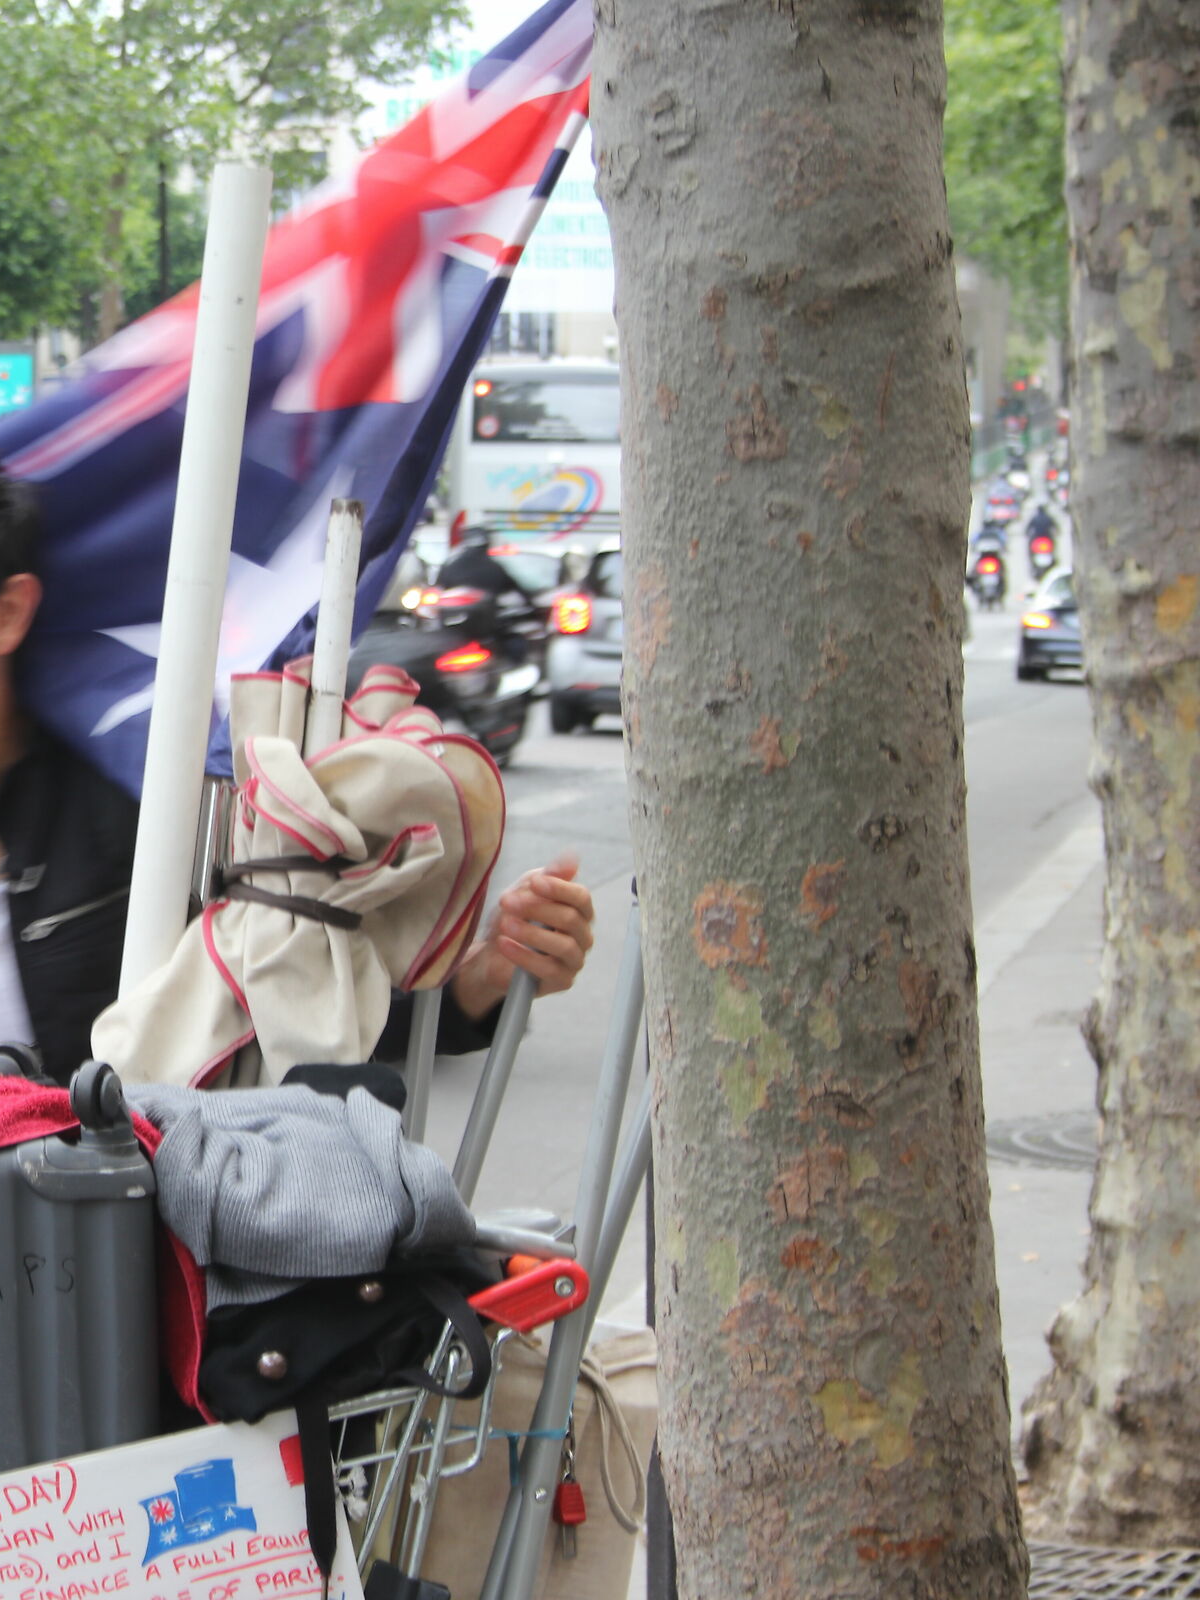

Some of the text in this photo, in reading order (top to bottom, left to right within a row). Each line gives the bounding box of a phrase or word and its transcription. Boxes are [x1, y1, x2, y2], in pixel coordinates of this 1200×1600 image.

[68, 1507, 126, 1537] WITH
[57, 1540, 102, 1570] and
[108, 1531, 131, 1561] I
[145, 1564, 161, 1581] A
[172, 1540, 236, 1575] FULLY
